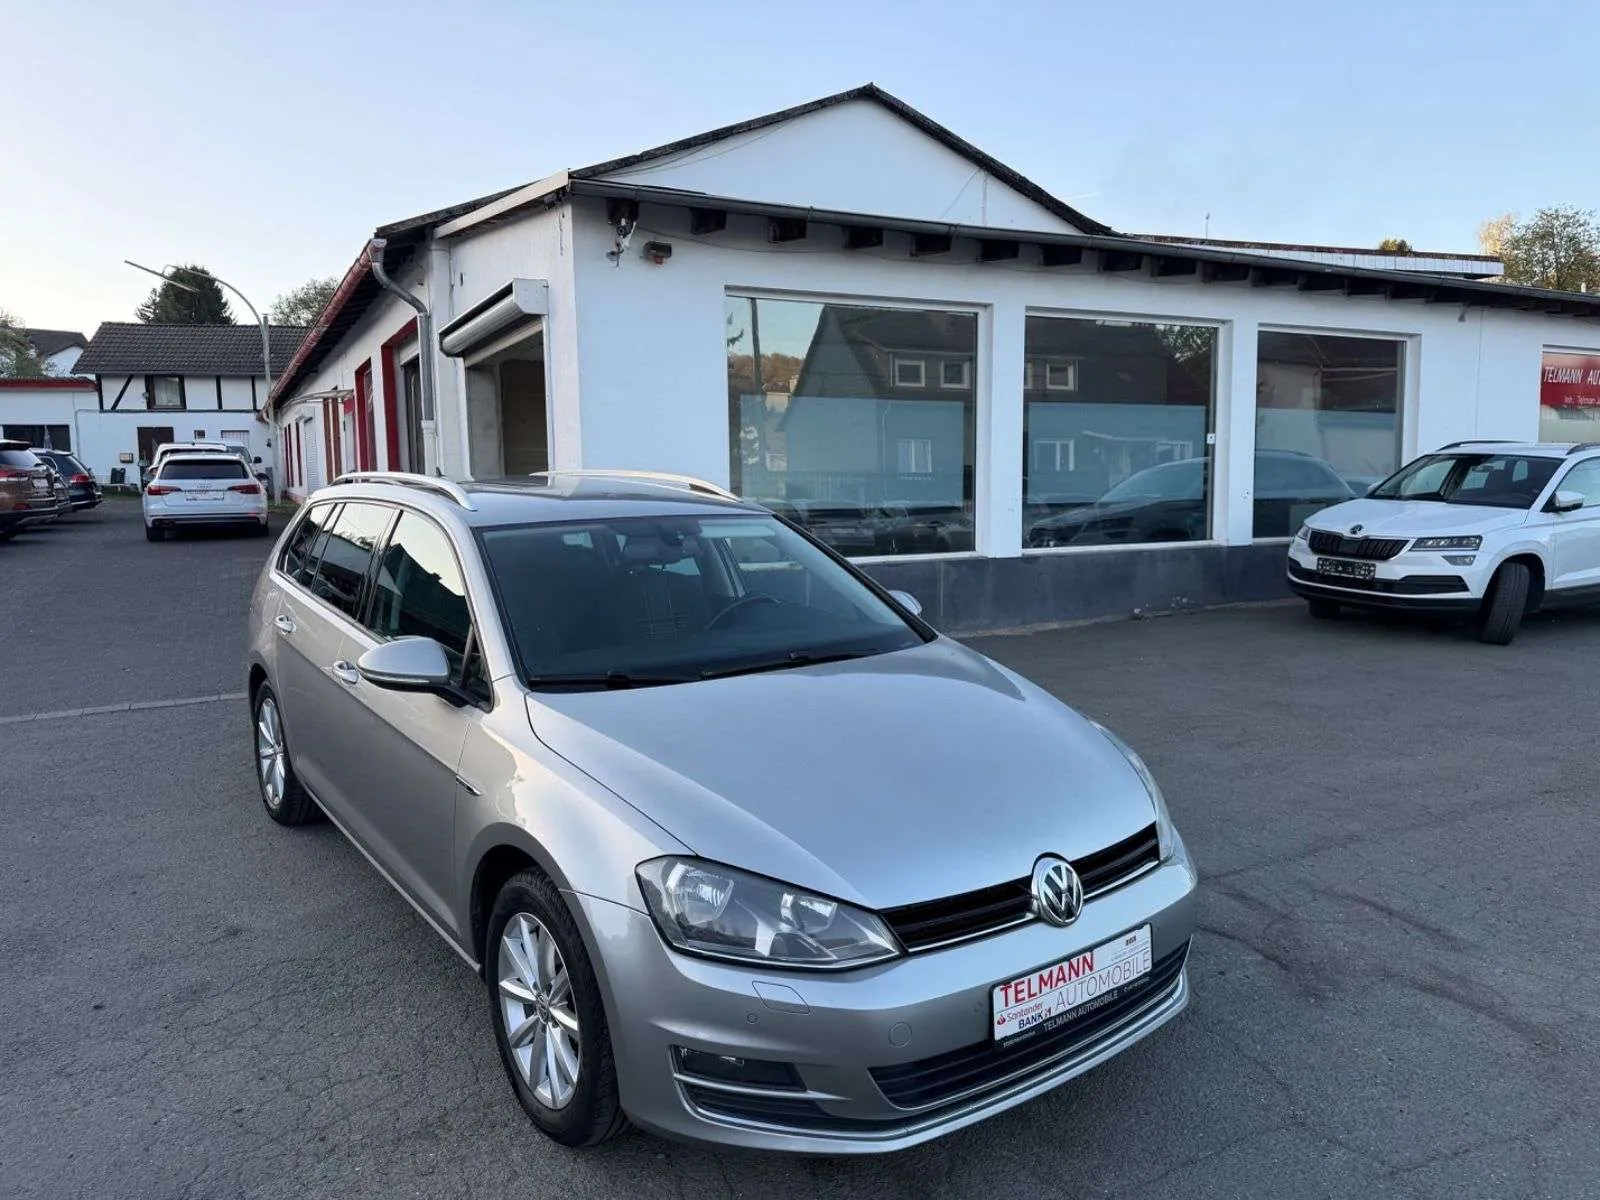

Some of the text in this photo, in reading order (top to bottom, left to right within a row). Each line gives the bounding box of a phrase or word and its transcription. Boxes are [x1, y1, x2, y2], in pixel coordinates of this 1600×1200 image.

[1543, 366, 1584, 384] TELMANN
[1000, 951, 1094, 1008] TELMANN
[1055, 950, 1151, 1011] AUTOMOBILE
[1006, 1001, 1043, 1022] Santander
[1018, 1010, 1044, 1029] BANK
[1043, 989, 1119, 1032] TELMANN AUTOMOBILE
